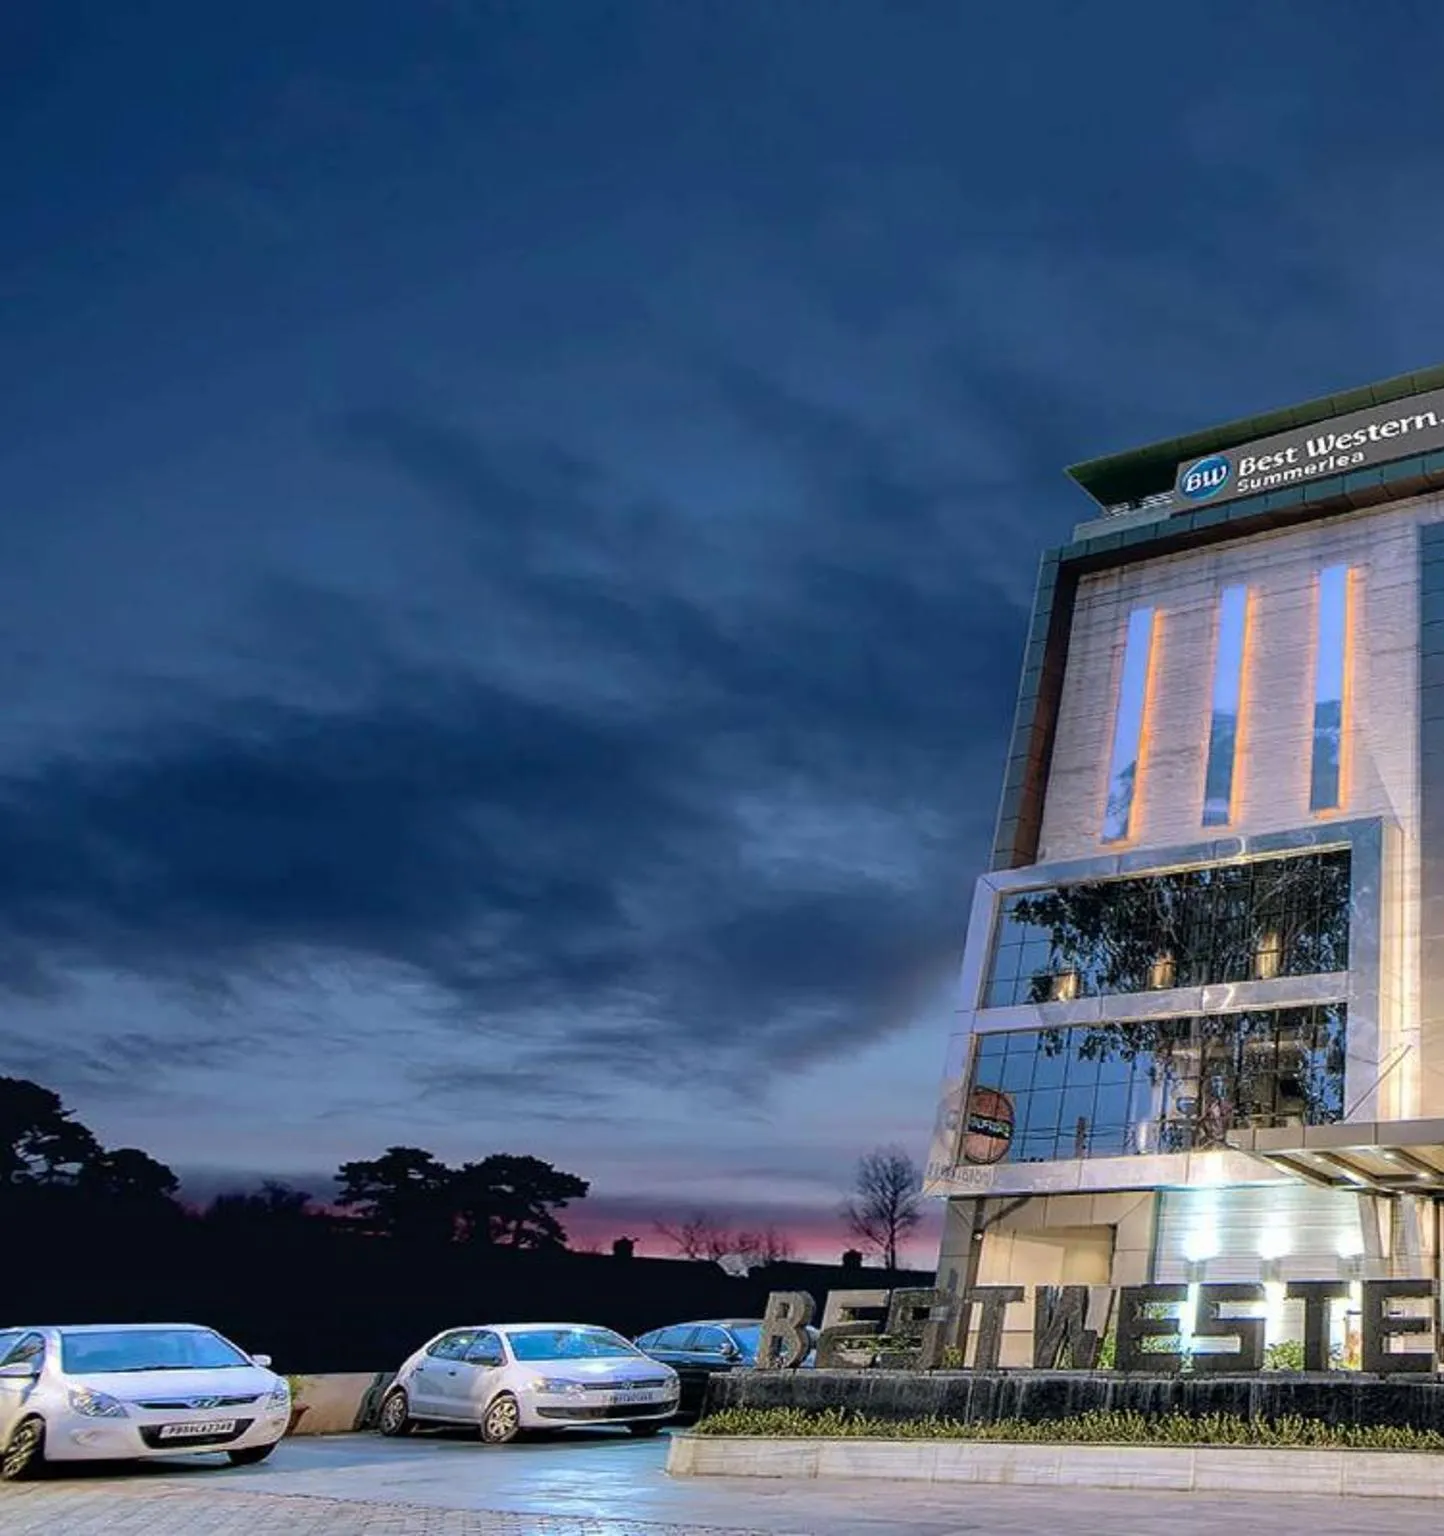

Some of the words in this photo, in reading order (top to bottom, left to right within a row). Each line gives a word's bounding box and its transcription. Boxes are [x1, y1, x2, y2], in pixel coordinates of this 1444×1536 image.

[1236, 451, 1365, 492] Summerlea
[1238, 447, 1299, 477] Best
[1184, 465, 1228, 493] BW
